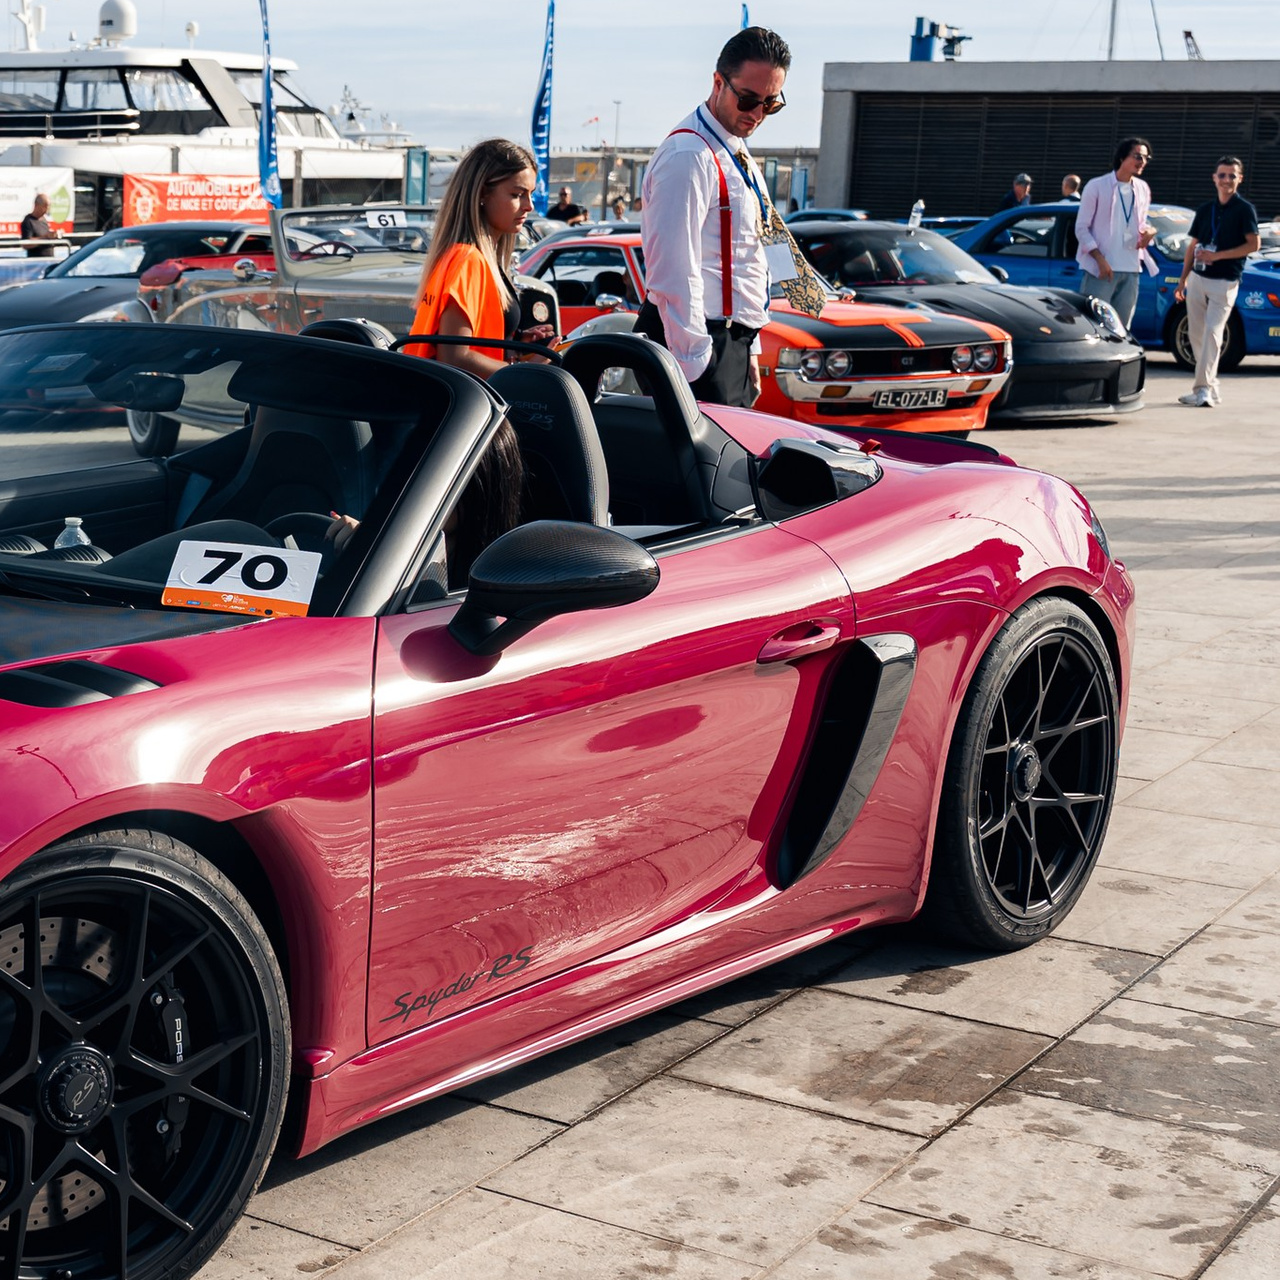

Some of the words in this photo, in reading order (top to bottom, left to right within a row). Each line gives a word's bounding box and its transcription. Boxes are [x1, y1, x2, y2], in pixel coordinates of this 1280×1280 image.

[377, 214, 397, 227] 61
[196, 549, 288, 591] 70
[378, 972, 486, 1024] Spyder
[486, 945, 534, 983] RS
